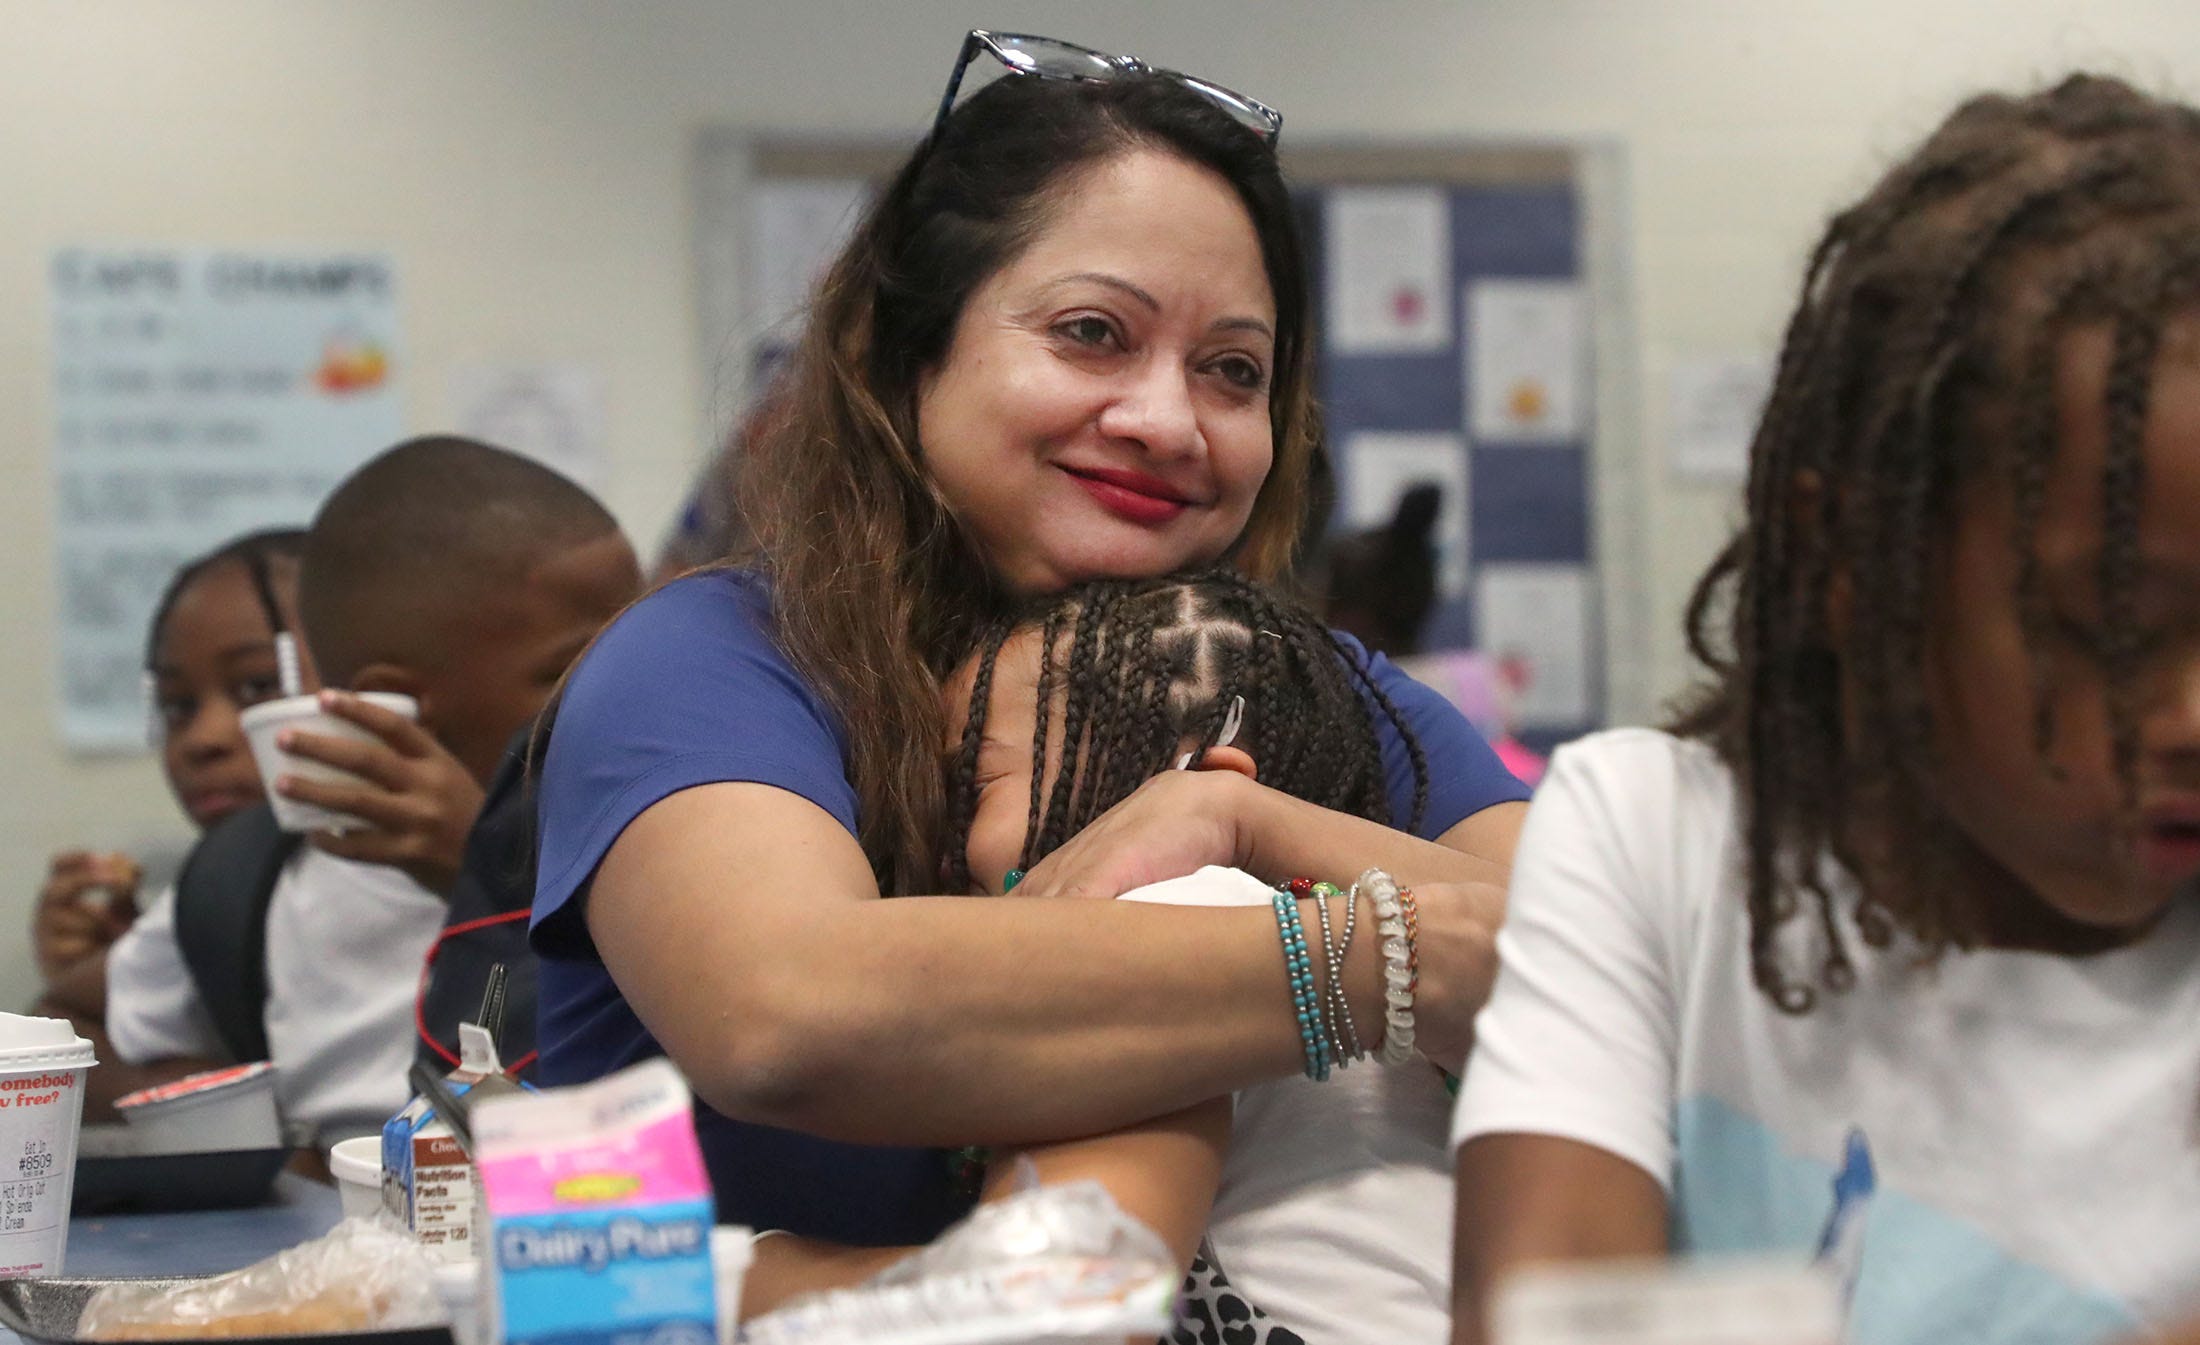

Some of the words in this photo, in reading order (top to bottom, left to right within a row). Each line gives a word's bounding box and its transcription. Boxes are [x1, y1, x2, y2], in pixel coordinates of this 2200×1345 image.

[0, 1072, 75, 1091] omebody
[16, 1091, 60, 1107] free?
[19, 1153, 52, 1170] #8509
[416, 1169, 466, 1183] Nutrition
[416, 1185, 449, 1198] Facts
[450, 1227, 468, 1240] 120
